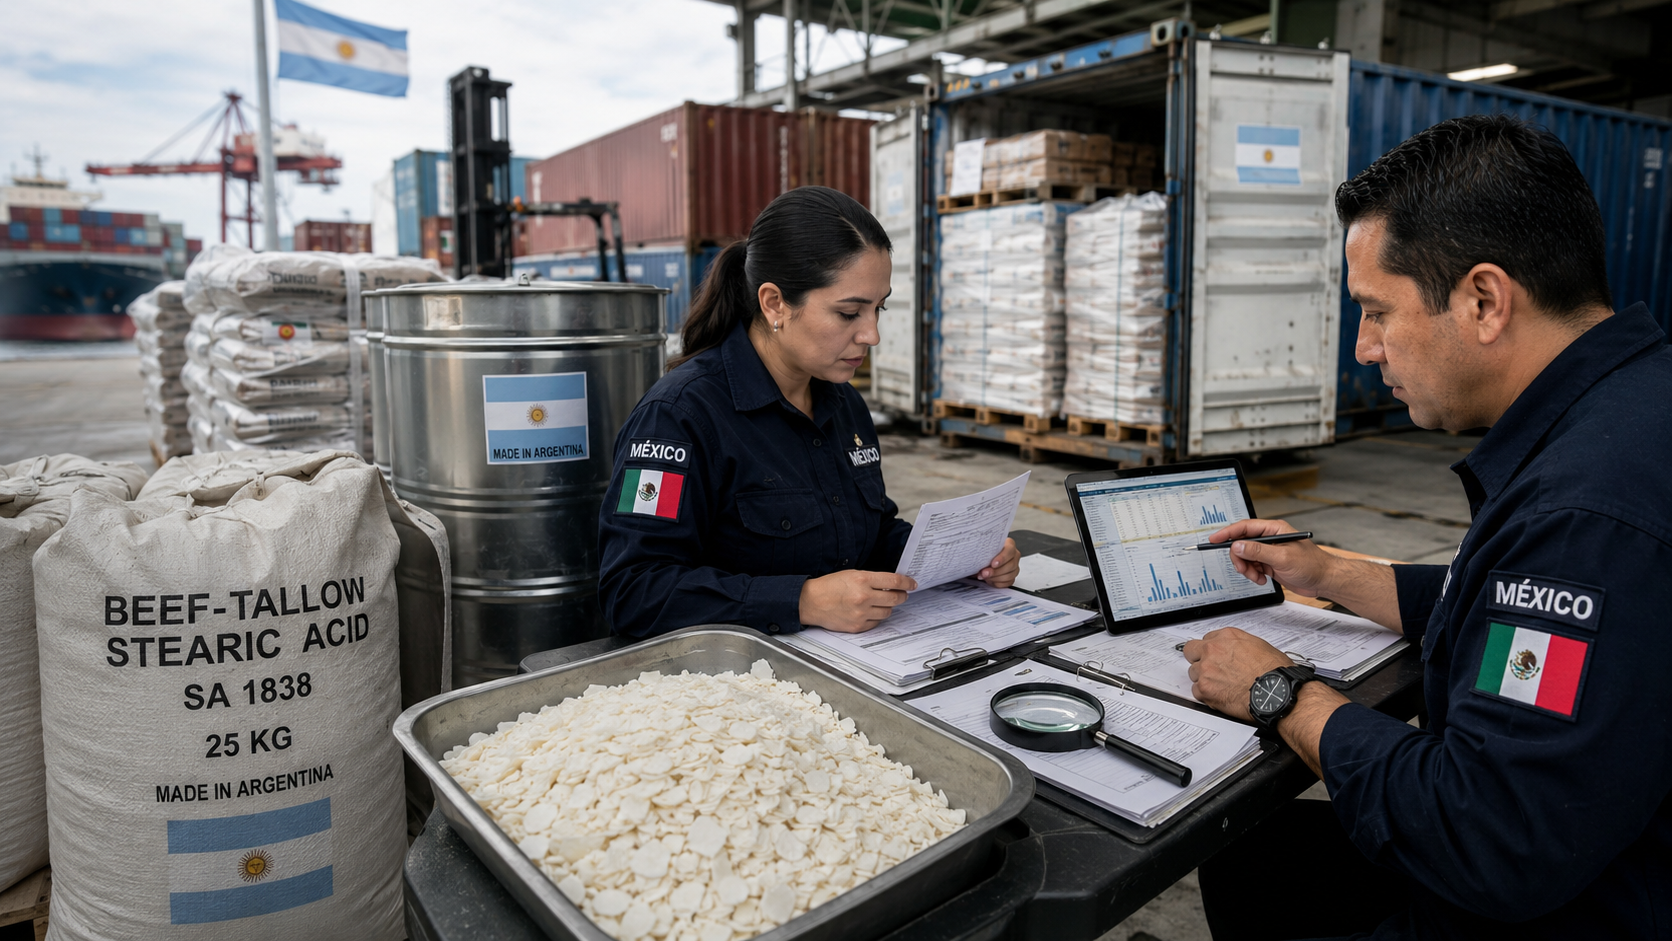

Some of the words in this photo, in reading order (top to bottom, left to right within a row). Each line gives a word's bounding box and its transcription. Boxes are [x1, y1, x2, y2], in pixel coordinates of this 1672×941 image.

[493, 448, 520, 460] MADE
[522, 448, 532, 459] IN
[533, 443, 584, 458] ARGENTINA
[630, 440, 686, 462] MÉXICO
[104, 576, 365, 626] BEEF-TALLOW
[1495, 578, 1594, 621] MÉXICO
[106, 628, 282, 668] STEARIC
[302, 612, 370, 654] ACID
[183, 682, 231, 711] SA
[242, 671, 312, 706] 1838
[205, 732, 240, 759] 25
[250, 725, 293, 755] KG
[155, 783, 209, 803] MADE
[214, 781, 232, 800] IN
[236, 763, 335, 798] ARGENTINA
